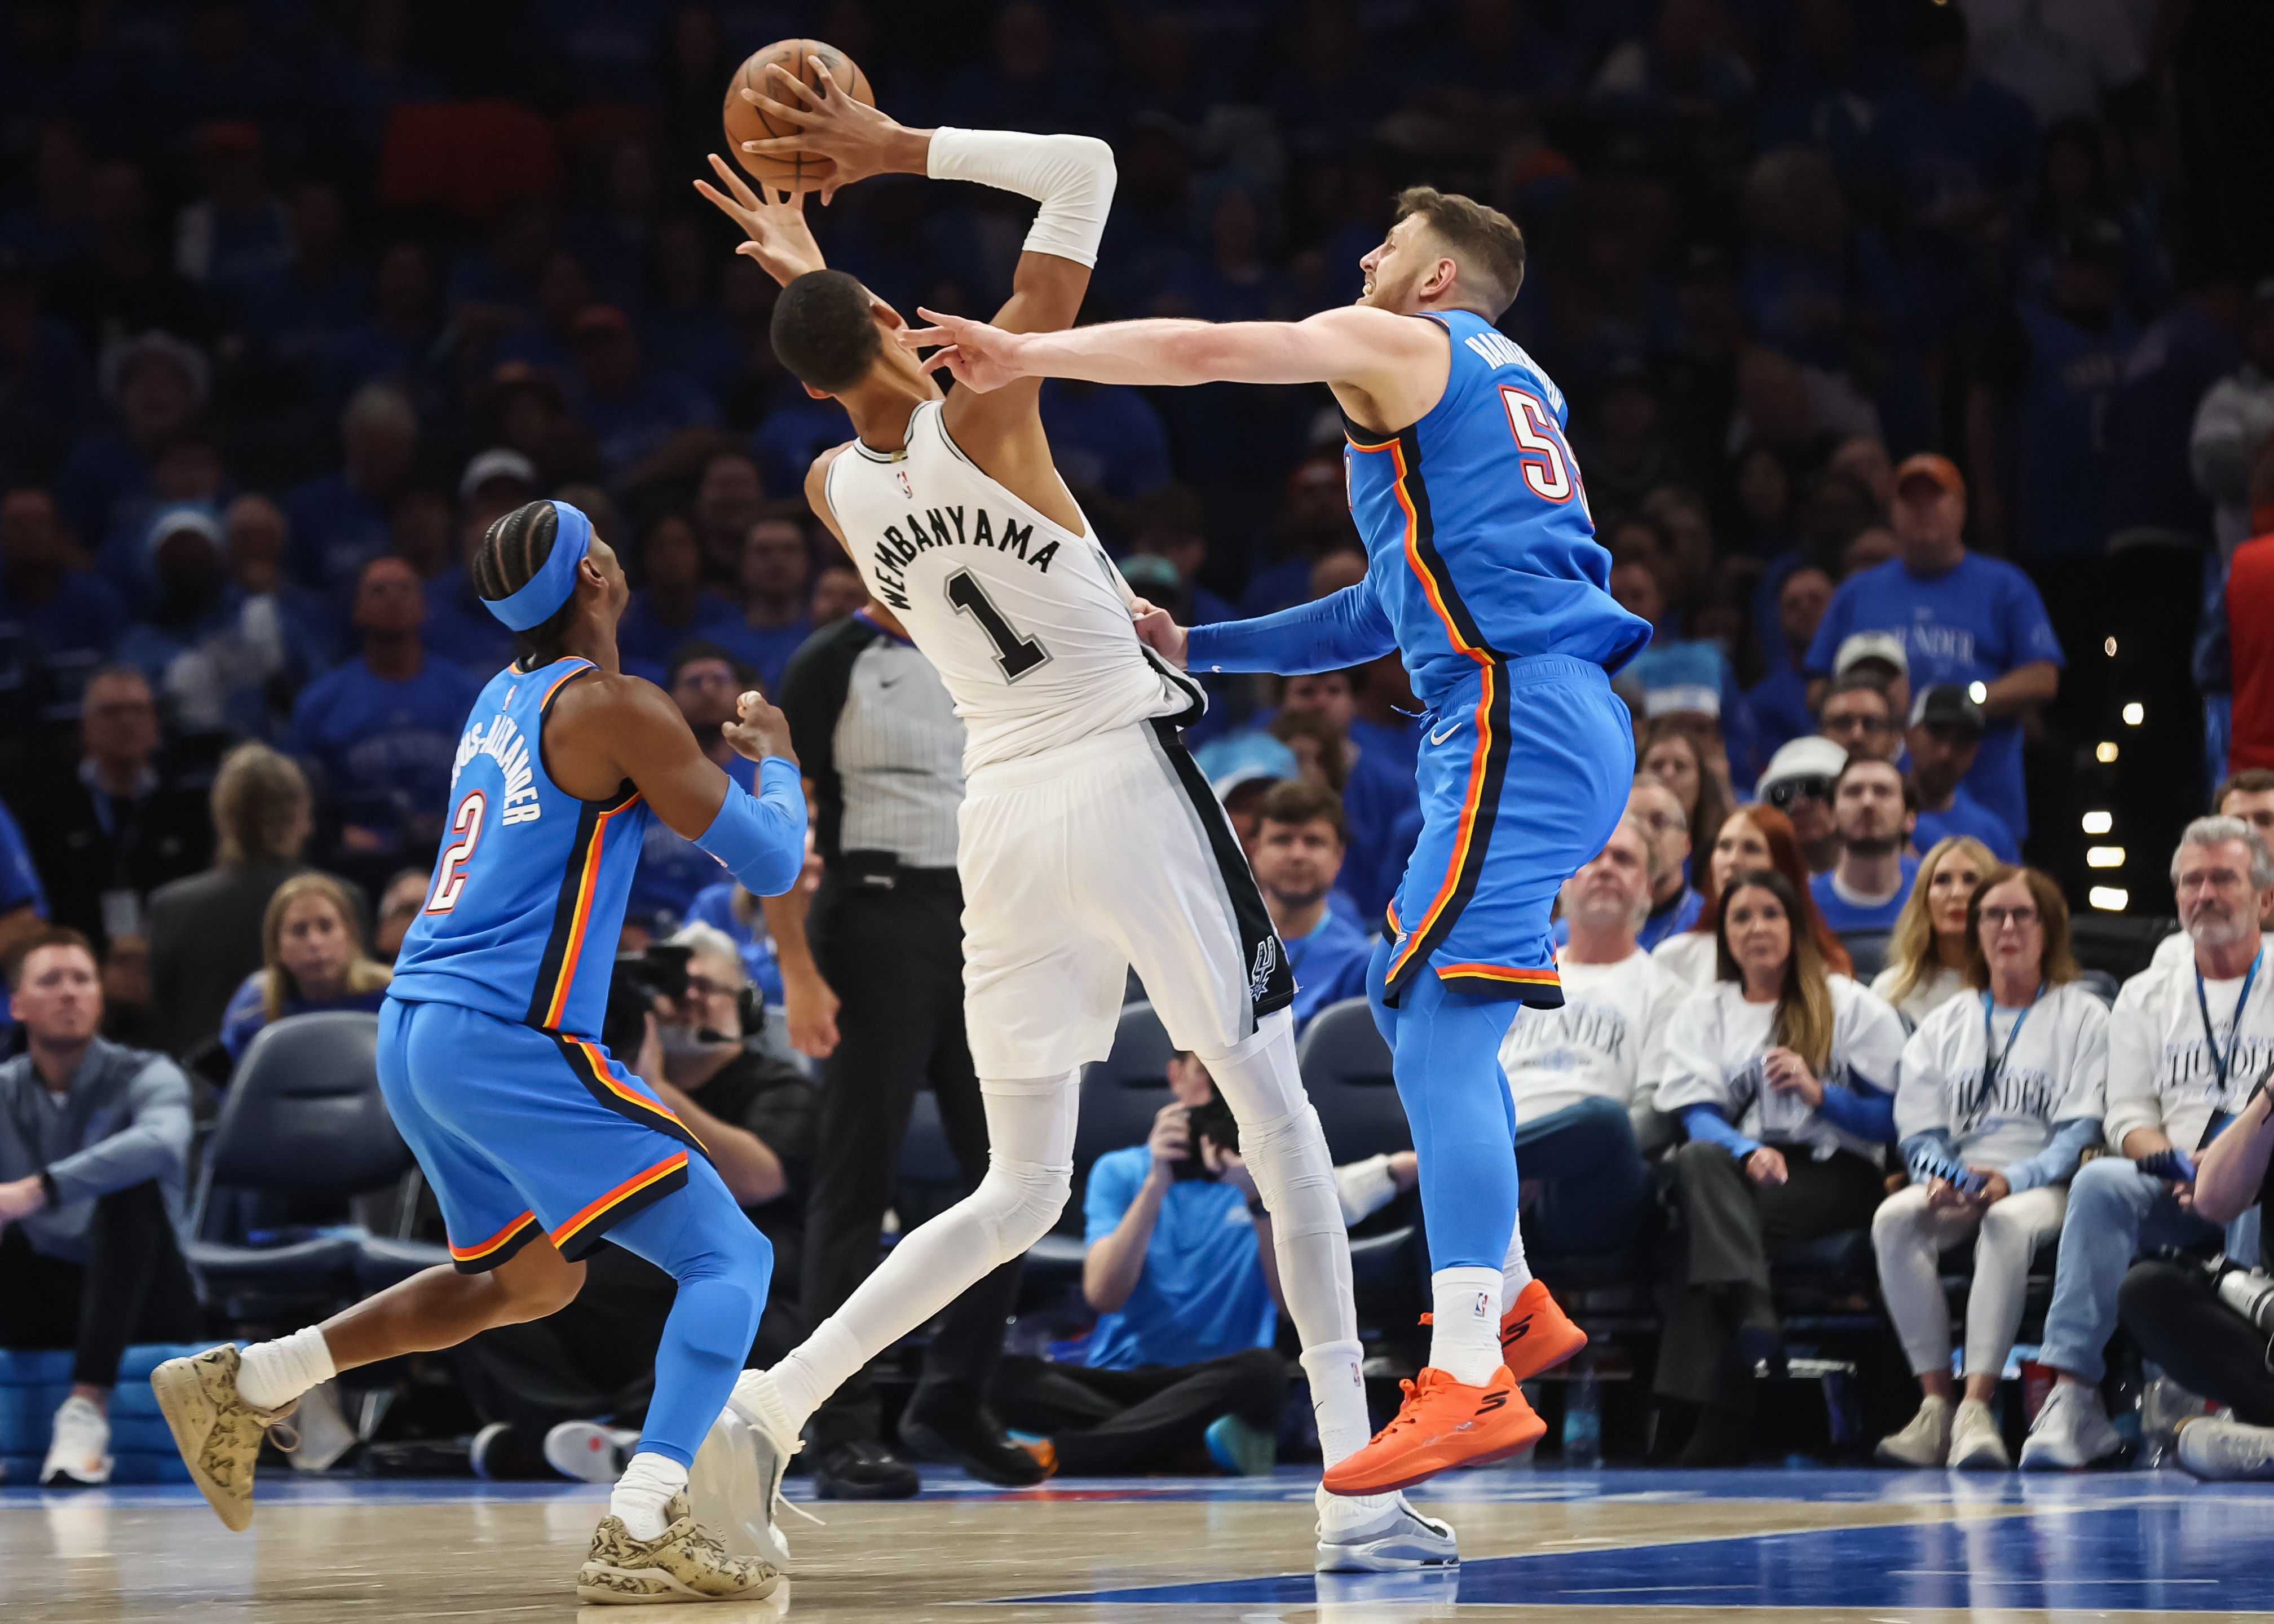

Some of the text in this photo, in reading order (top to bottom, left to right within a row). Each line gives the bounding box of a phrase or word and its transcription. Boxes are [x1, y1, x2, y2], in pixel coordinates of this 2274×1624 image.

[874, 505, 1061, 611] WEMBANYAMA
[944, 565, 1054, 686] 1
[422, 789, 487, 916] 2
